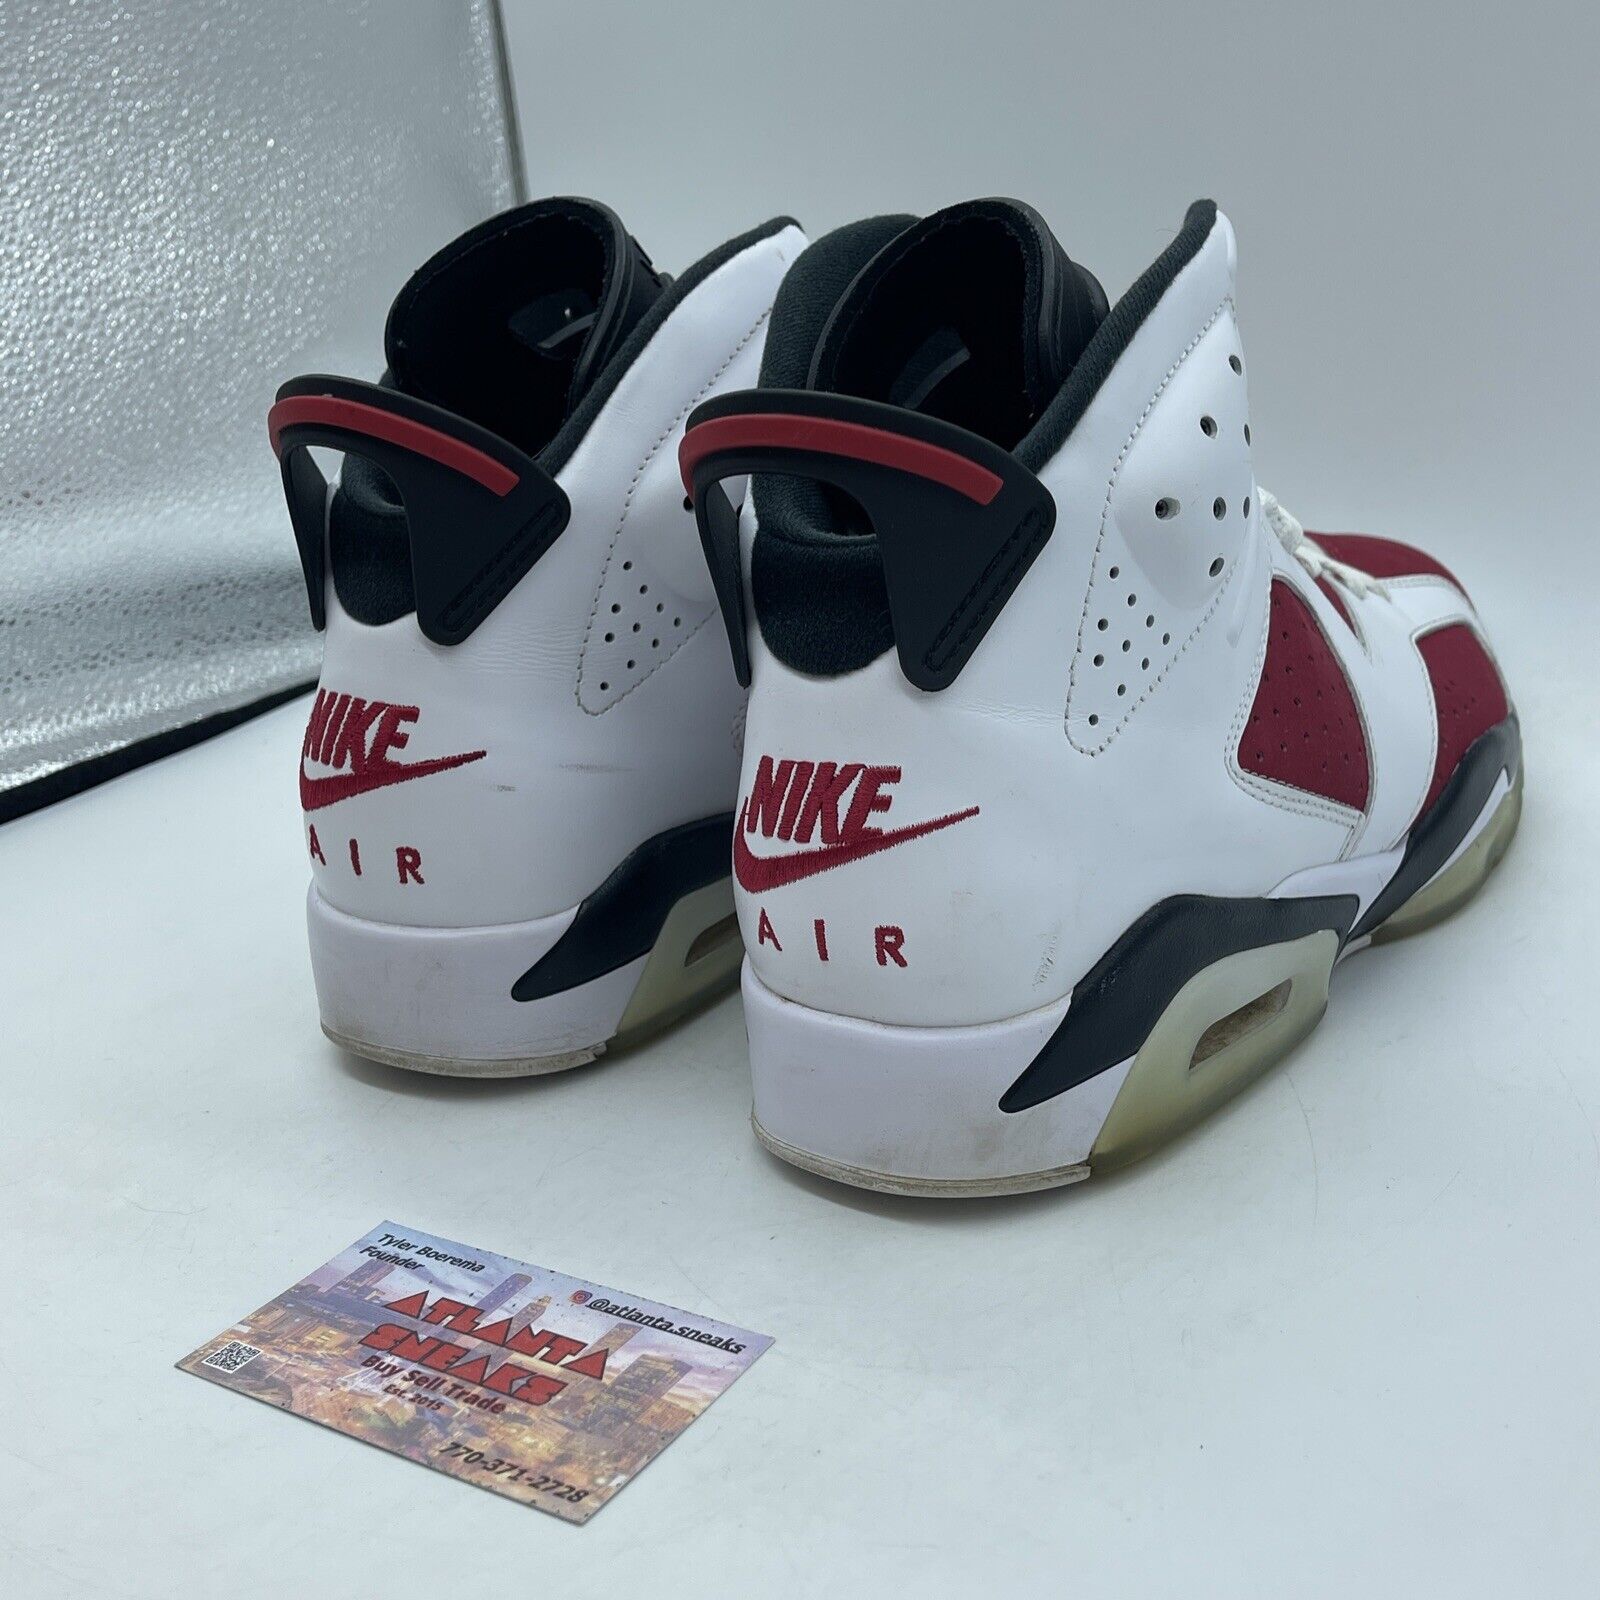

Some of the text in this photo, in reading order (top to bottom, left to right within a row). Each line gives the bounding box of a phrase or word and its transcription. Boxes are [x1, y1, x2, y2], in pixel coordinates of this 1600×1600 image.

[304, 688, 420, 774] NIKE
[746, 755, 902, 845] NIKE
[309, 824, 425, 885] AIR
[758, 907, 908, 967] AIR
[359, 1245, 425, 1273] Founder
[377, 1232, 486, 1274] Tyler Boerema
[383, 1290, 612, 1380] ATLANTA
[588, 1295, 747, 1356] @atlanta.sneaks
[358, 1323, 569, 1407] SNEAKS
[360, 1353, 507, 1416] Buy Sell Trade
[382, 1383, 444, 1412] Est. 2015
[439, 1441, 591, 1506] 770-371-2728
